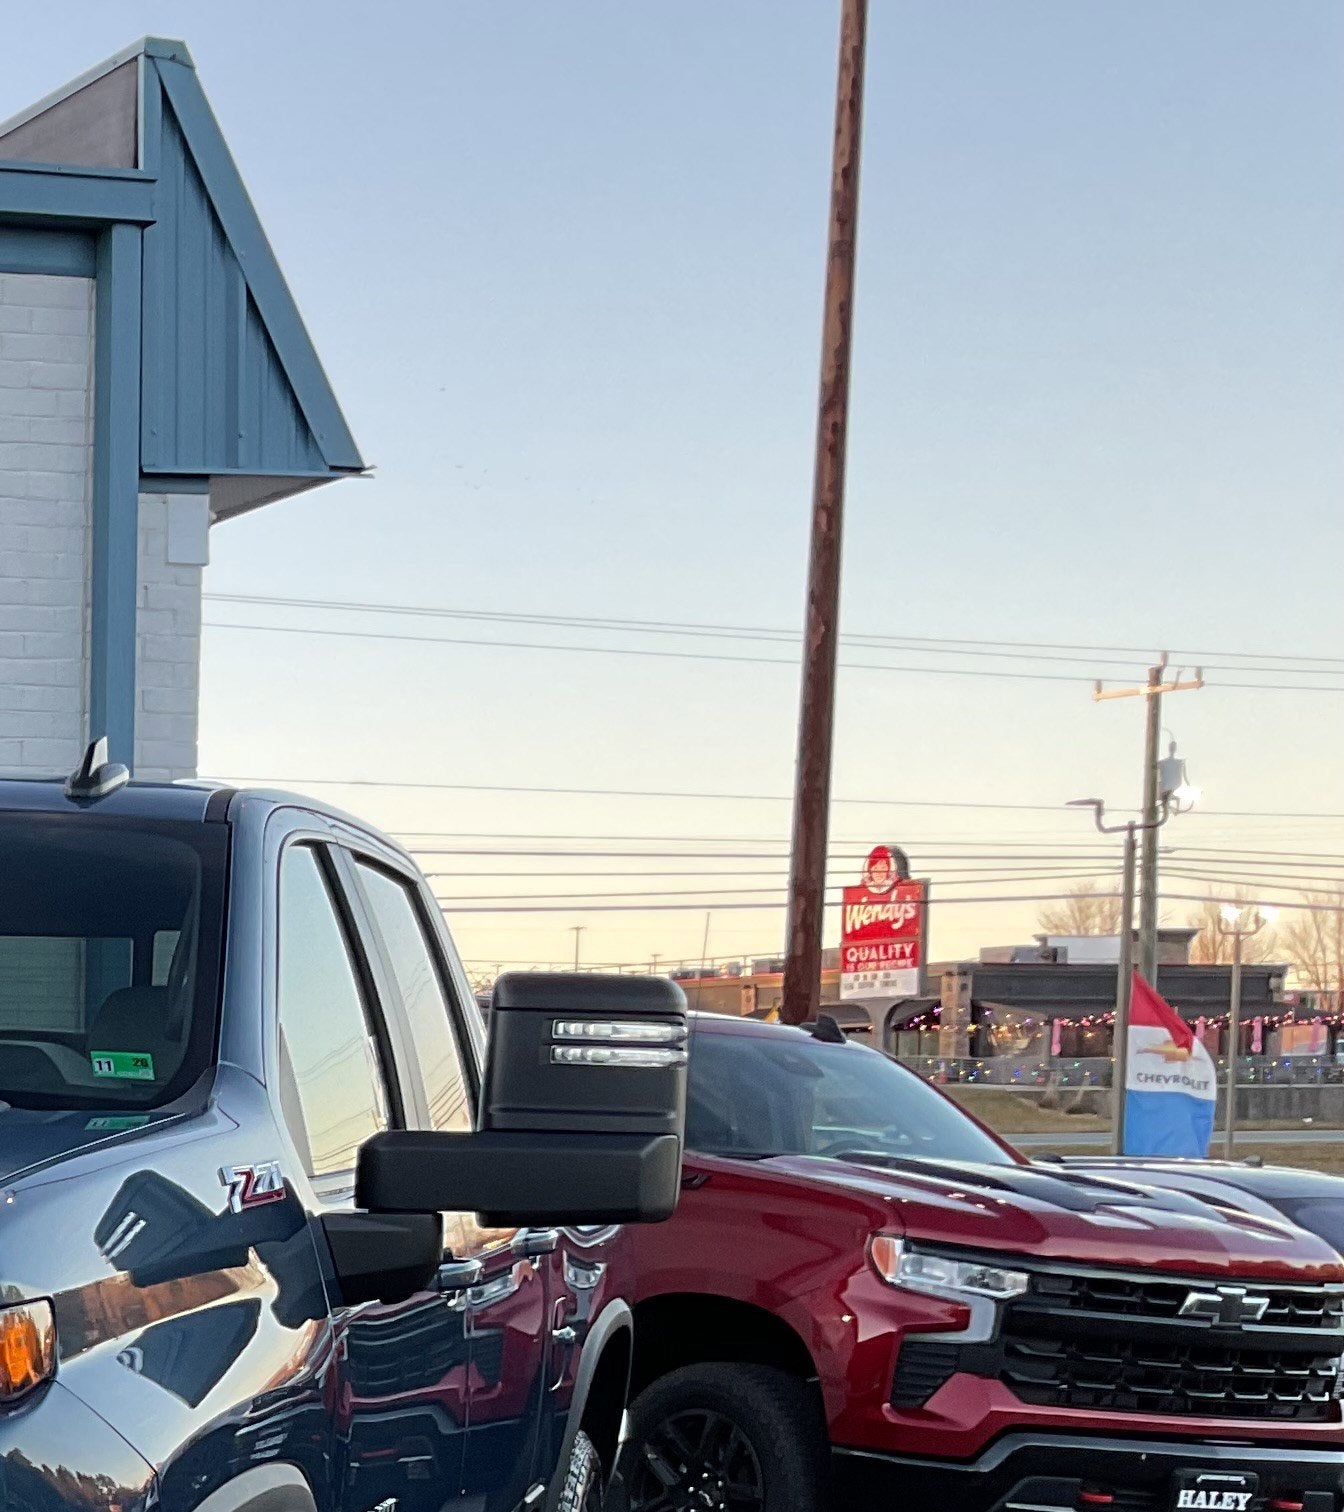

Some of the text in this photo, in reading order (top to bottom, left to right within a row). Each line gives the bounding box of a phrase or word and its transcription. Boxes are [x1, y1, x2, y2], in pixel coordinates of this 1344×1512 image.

[845, 889, 917, 934] Wendy's
[846, 943, 914, 962] QUALITY
[96, 1060, 112, 1071] 11
[1177, 1489, 1253, 1511] HALEY
